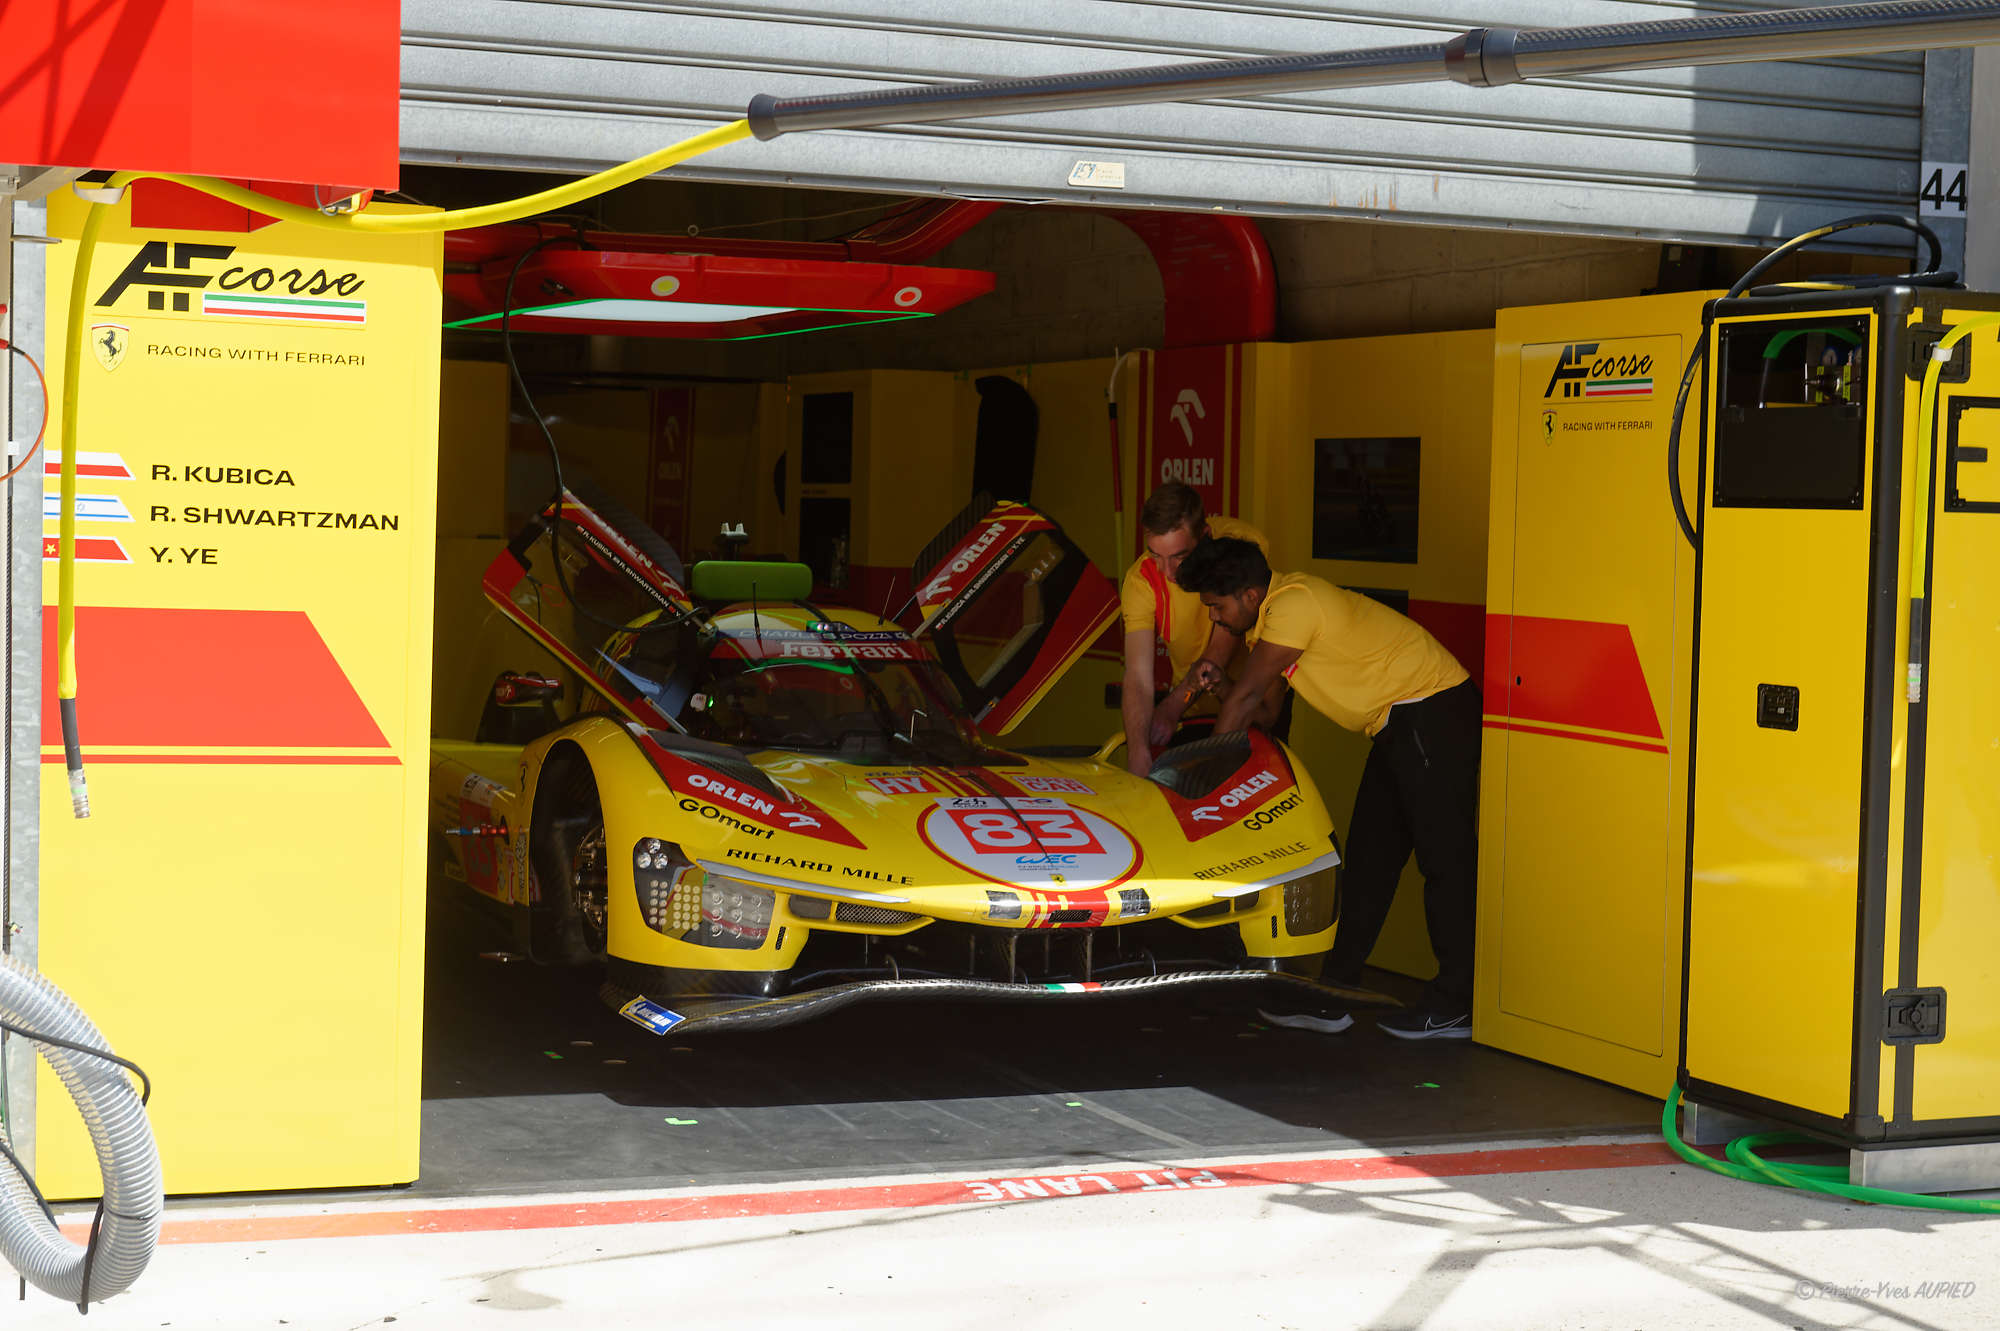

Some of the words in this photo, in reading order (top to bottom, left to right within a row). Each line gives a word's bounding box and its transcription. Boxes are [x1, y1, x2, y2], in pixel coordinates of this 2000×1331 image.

[1921, 168, 1967, 211] 44
[219, 267, 365, 296] corse
[148, 344, 222, 359] RACING
[228, 348, 278, 362] WITH
[285, 352, 365, 366] FERRARI
[1592, 354, 1653, 378] corse
[1563, 422, 1592, 431] RACING
[1595, 421, 1615, 430] WITH
[1618, 421, 1653, 430] FERRARI
[152, 464, 177, 481] R.
[185, 465, 295, 486] KUBICA
[1161, 457, 1215, 486] ORLEN
[150, 506, 176, 522] R.
[183, 507, 399, 531] SHWARTZMAN
[150, 547, 173, 563] Y.
[180, 548, 218, 564] YE
[952, 522, 1007, 573] ORLEN
[779, 642, 912, 660] Ferrari
[688, 775, 774, 816] ORLEN
[868, 778, 927, 793] HY
[1220, 770, 1279, 807] ORLEN
[679, 799, 775, 839] GOmart
[1243, 792, 1304, 831] GOmart
[963, 813, 1091, 847] 83
[727, 849, 832, 872] RICHARD
[843, 867, 913, 886] MILLE
[1194, 855, 1264, 880] RICHARD
[1263, 842, 1311, 860] MILLE
[964, 1175, 1121, 1201] LANE
[1133, 1170, 1227, 1191] PIT
